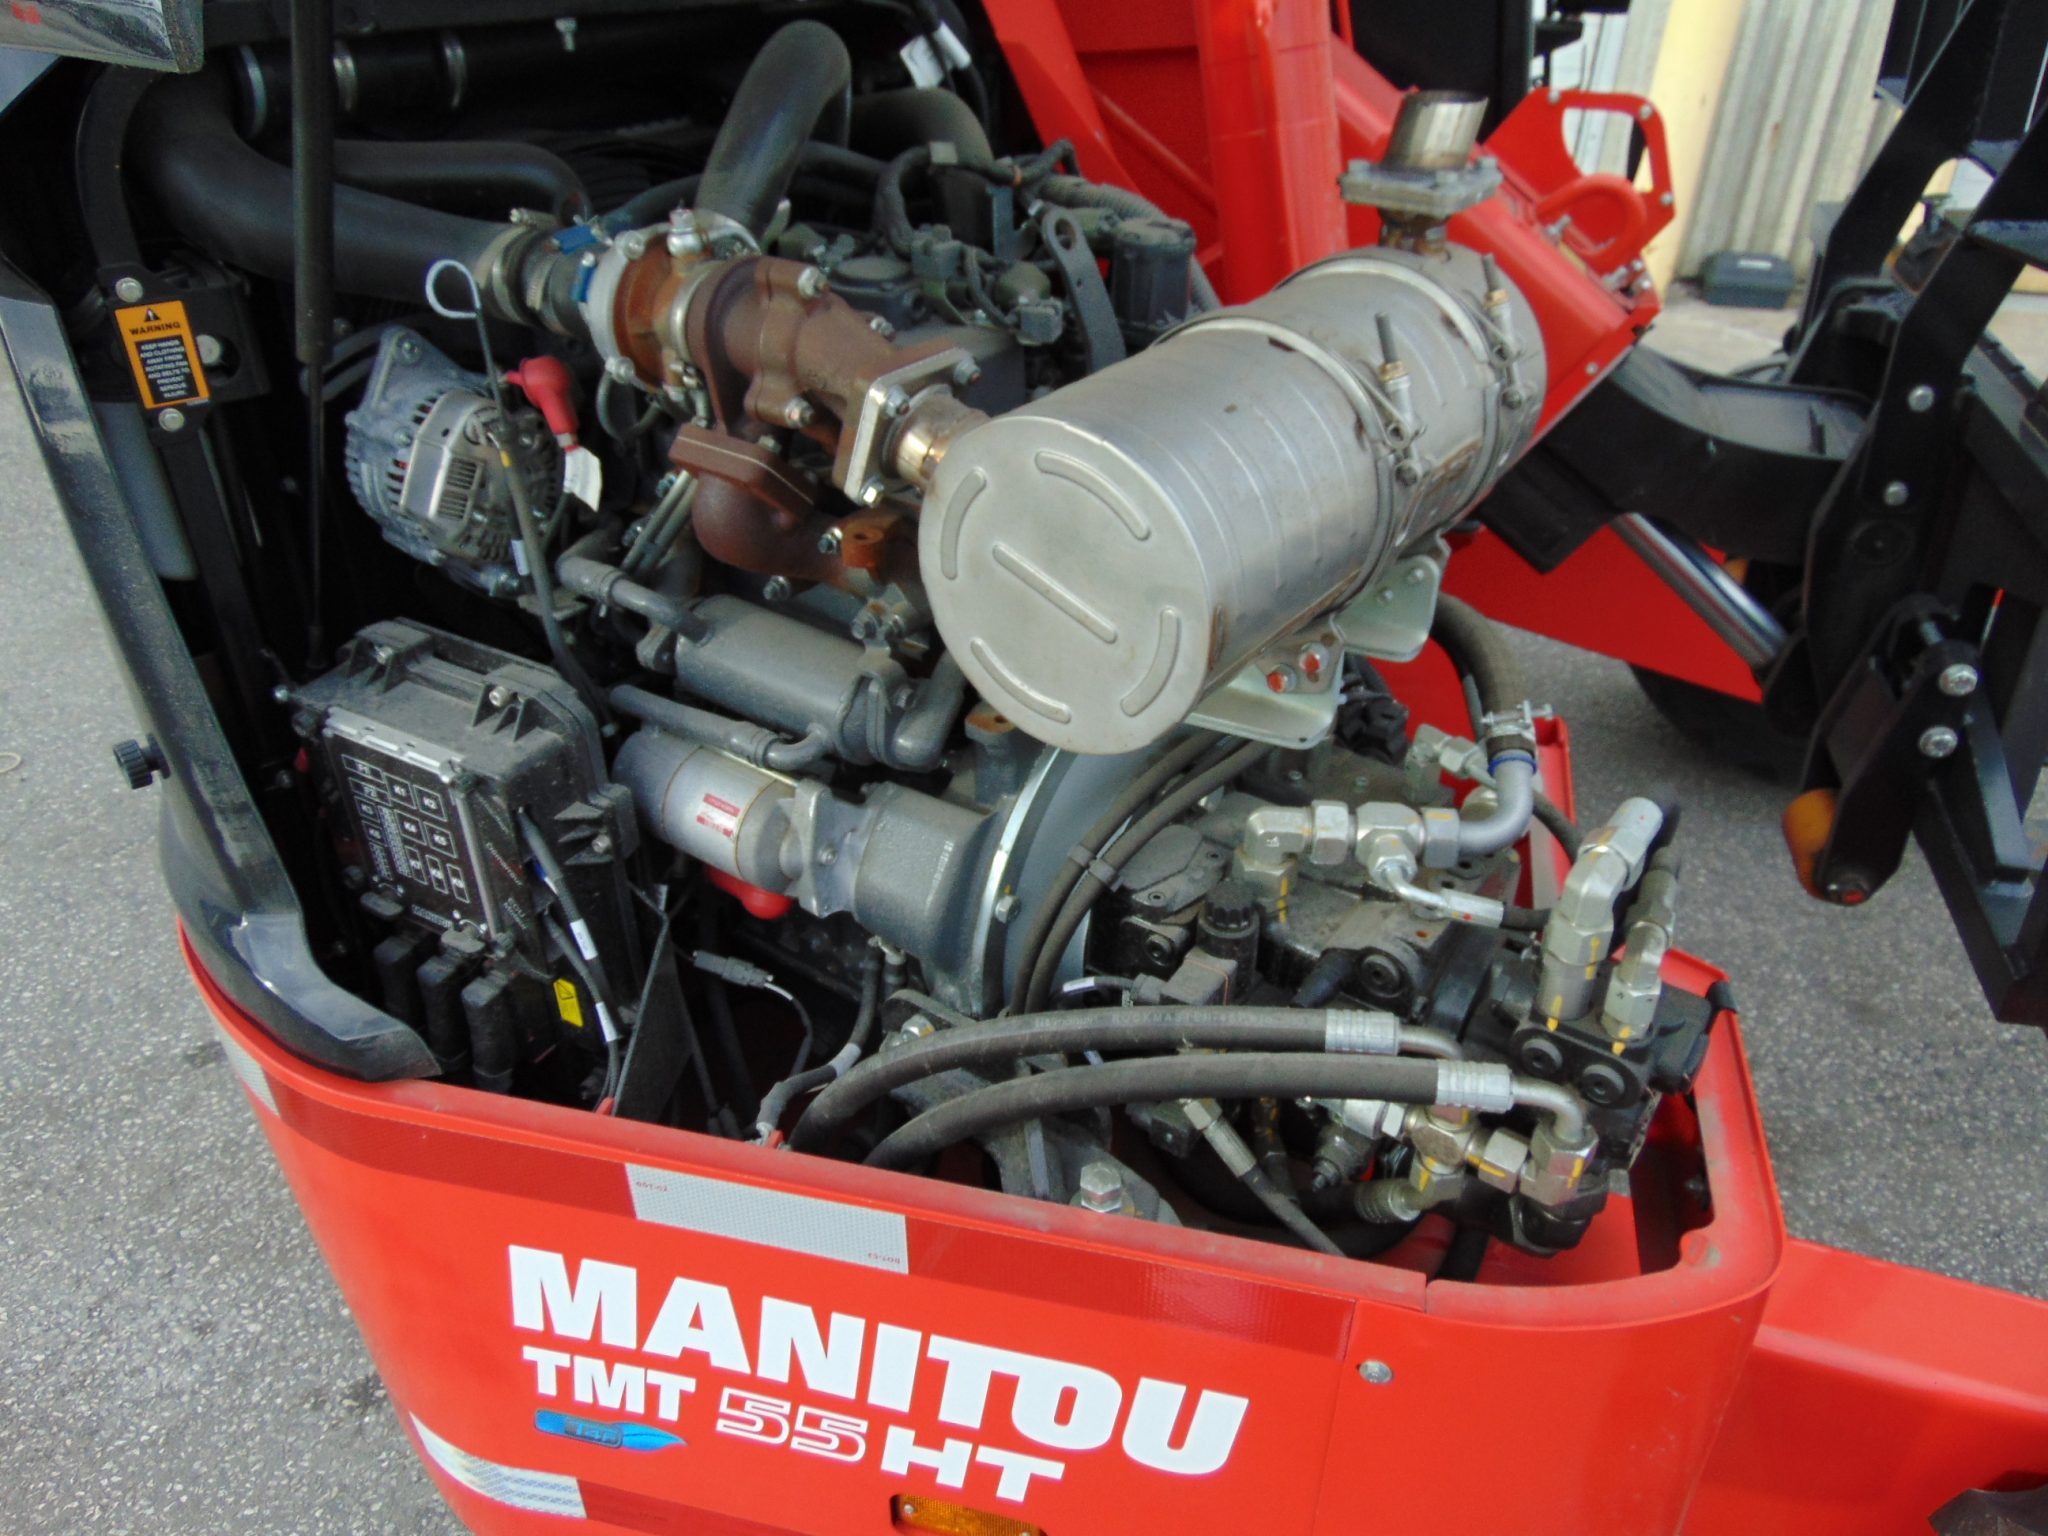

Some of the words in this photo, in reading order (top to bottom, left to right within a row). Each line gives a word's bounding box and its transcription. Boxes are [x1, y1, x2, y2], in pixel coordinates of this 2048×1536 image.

[131, 322, 180, 334] WARNING
[509, 1244, 1249, 1475] MANITOU
[522, 1346, 696, 1422] TMT
[716, 1386, 869, 1463] 55
[880, 1427, 1065, 1503] HT
